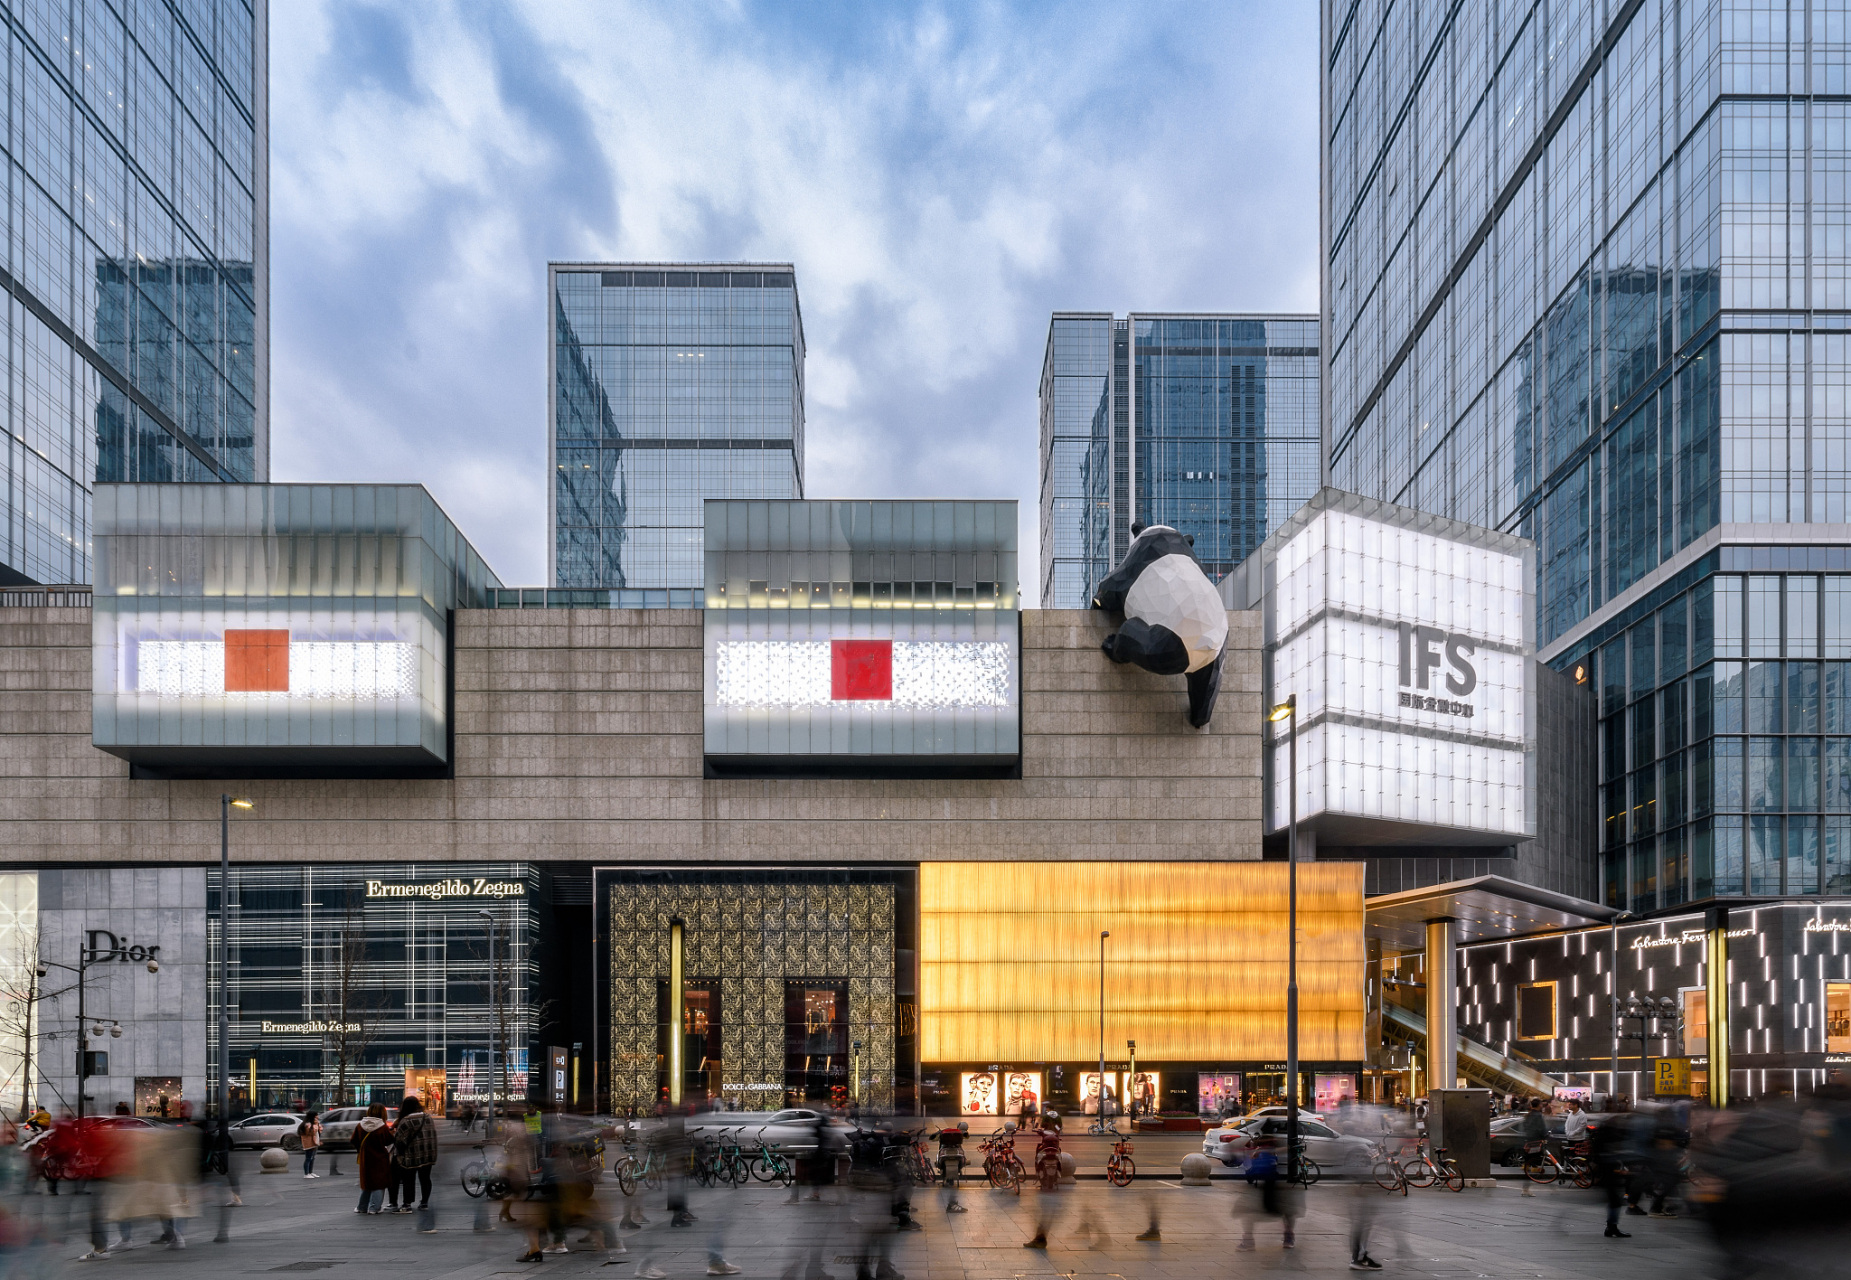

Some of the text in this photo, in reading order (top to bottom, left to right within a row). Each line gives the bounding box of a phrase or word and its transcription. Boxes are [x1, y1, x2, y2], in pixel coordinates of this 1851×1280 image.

[1398, 620, 1477, 697] IFS
[365, 878, 525, 900] Ermenegildo Zegna
[1803, 917, 1850, 933] Salvatore
[85, 930, 161, 963] Dior
[1630, 929, 1755, 950] Salvatore Ferrmo
[261, 1020, 328, 1034] Ermenegildo
[1660, 1062, 1672, 1080] P
[452, 1091, 501, 1103] Ermenegido
